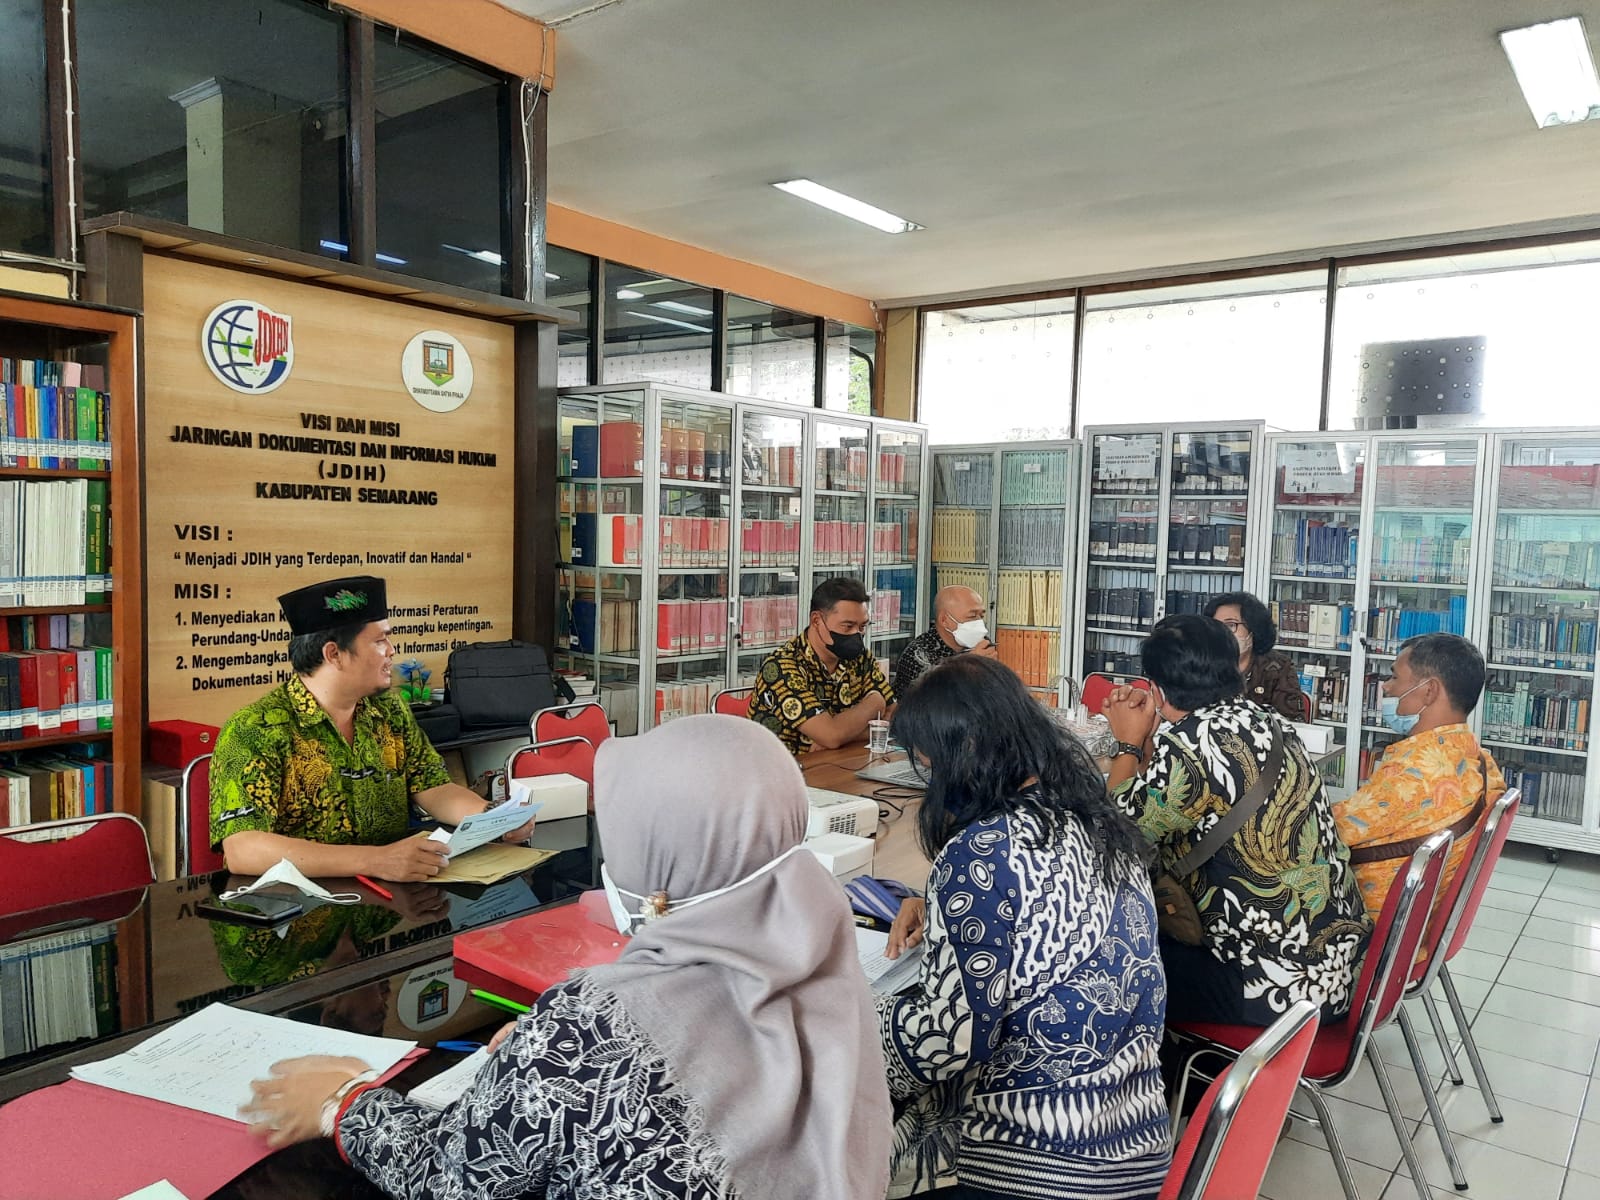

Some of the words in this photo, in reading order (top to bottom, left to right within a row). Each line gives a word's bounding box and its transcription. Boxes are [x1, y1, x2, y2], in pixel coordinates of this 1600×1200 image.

[300, 412, 332, 431] VISI
[336, 417, 366, 434] DAN
[370, 420, 400, 438] MISI
[170, 425, 253, 448] JARINGAN
[258, 433, 356, 457] DOKUMENTASI
[360, 442, 387, 460] DAN
[390, 445, 454, 464] INFORMASI
[458, 450, 497, 467] HUKUM
[318, 459, 386, 483] (JDIH)
[256, 482, 352, 502] KABUPATEN
[358, 487, 438, 506] SEMARANG
[174, 524, 220, 541] VISI
[185, 551, 237, 569] Menjadi
[241, 551, 272, 566] JDIH
[275, 554, 303, 568] yang
[307, 551, 363, 567] Terdepan,
[366, 551, 406, 564] Inovatif
[409, 552, 428, 564] dan
[430, 551, 464, 564] Handal
[174, 583, 219, 599] MISI
[175, 611, 187, 626] 1.
[191, 609, 275, 628] Menyediakan
[386, 604, 431, 617] nformasi
[433, 603, 479, 616] Peraturan
[391, 621, 435, 637] emangku
[437, 619, 494, 634] kepentingan.
[176, 655, 188, 670] 2.
[192, 650, 289, 670] Mengembangka
[403, 639, 448, 654] Informasi
[192, 671, 273, 691] Dokumentasi
